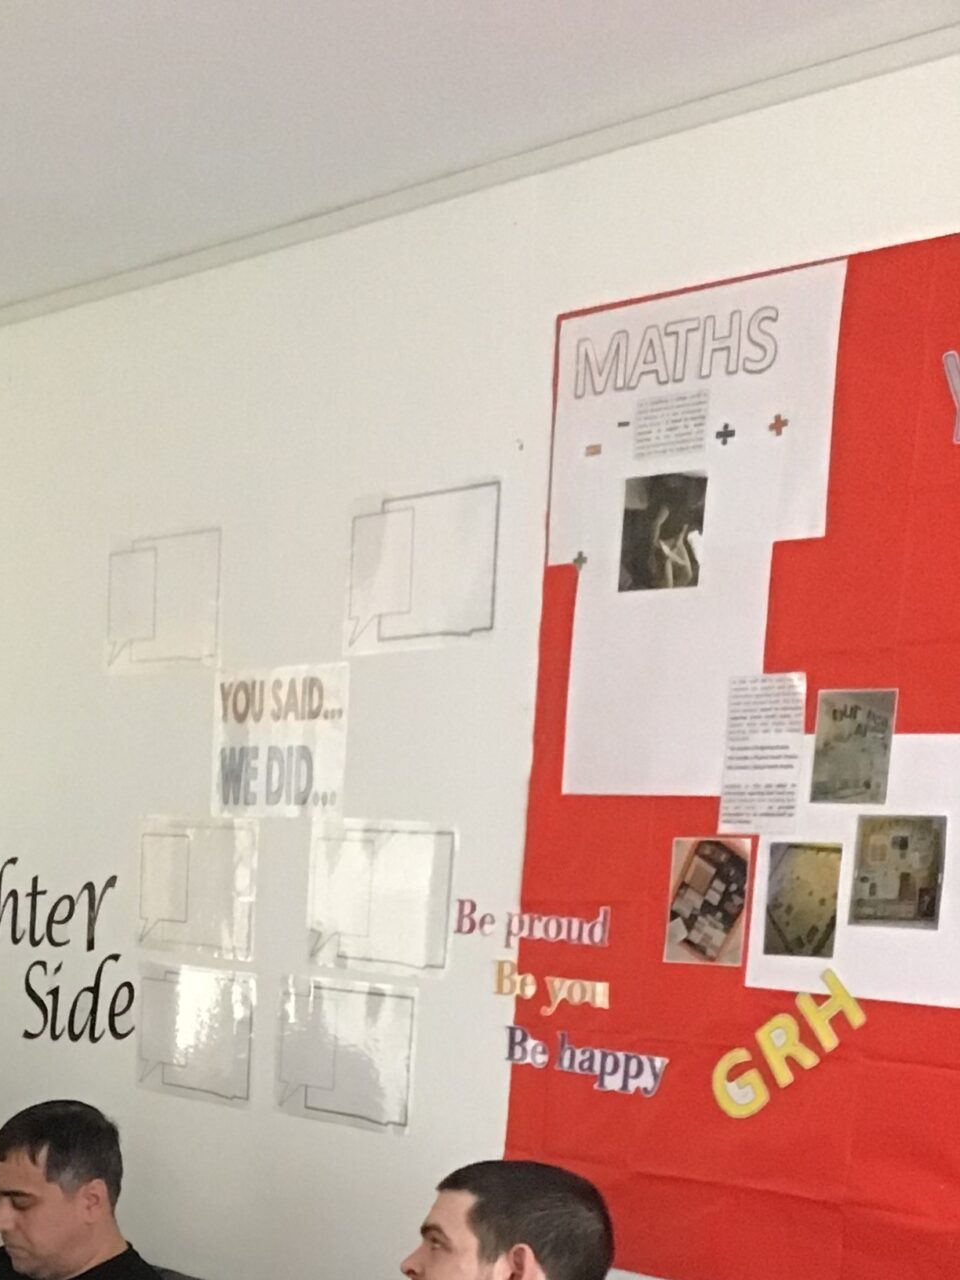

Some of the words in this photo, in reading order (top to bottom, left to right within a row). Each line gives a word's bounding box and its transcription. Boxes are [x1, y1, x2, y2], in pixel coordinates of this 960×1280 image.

[574, 305, 780, 400] MATHS
[220, 680, 265, 724] YOU
[270, 676, 343, 722] SAID...
[220, 746, 259, 805] WE
[265, 745, 337, 807] DID...
[455, 899, 495, 935] Be
[505, 906, 610, 948] proud
[22, 953, 135, 1043] Side
[493, 959, 537, 999] Be
[505, 1025, 549, 1068] Be
[555, 1030, 669, 1097] happy
[712, 967, 867, 1119] GRH
